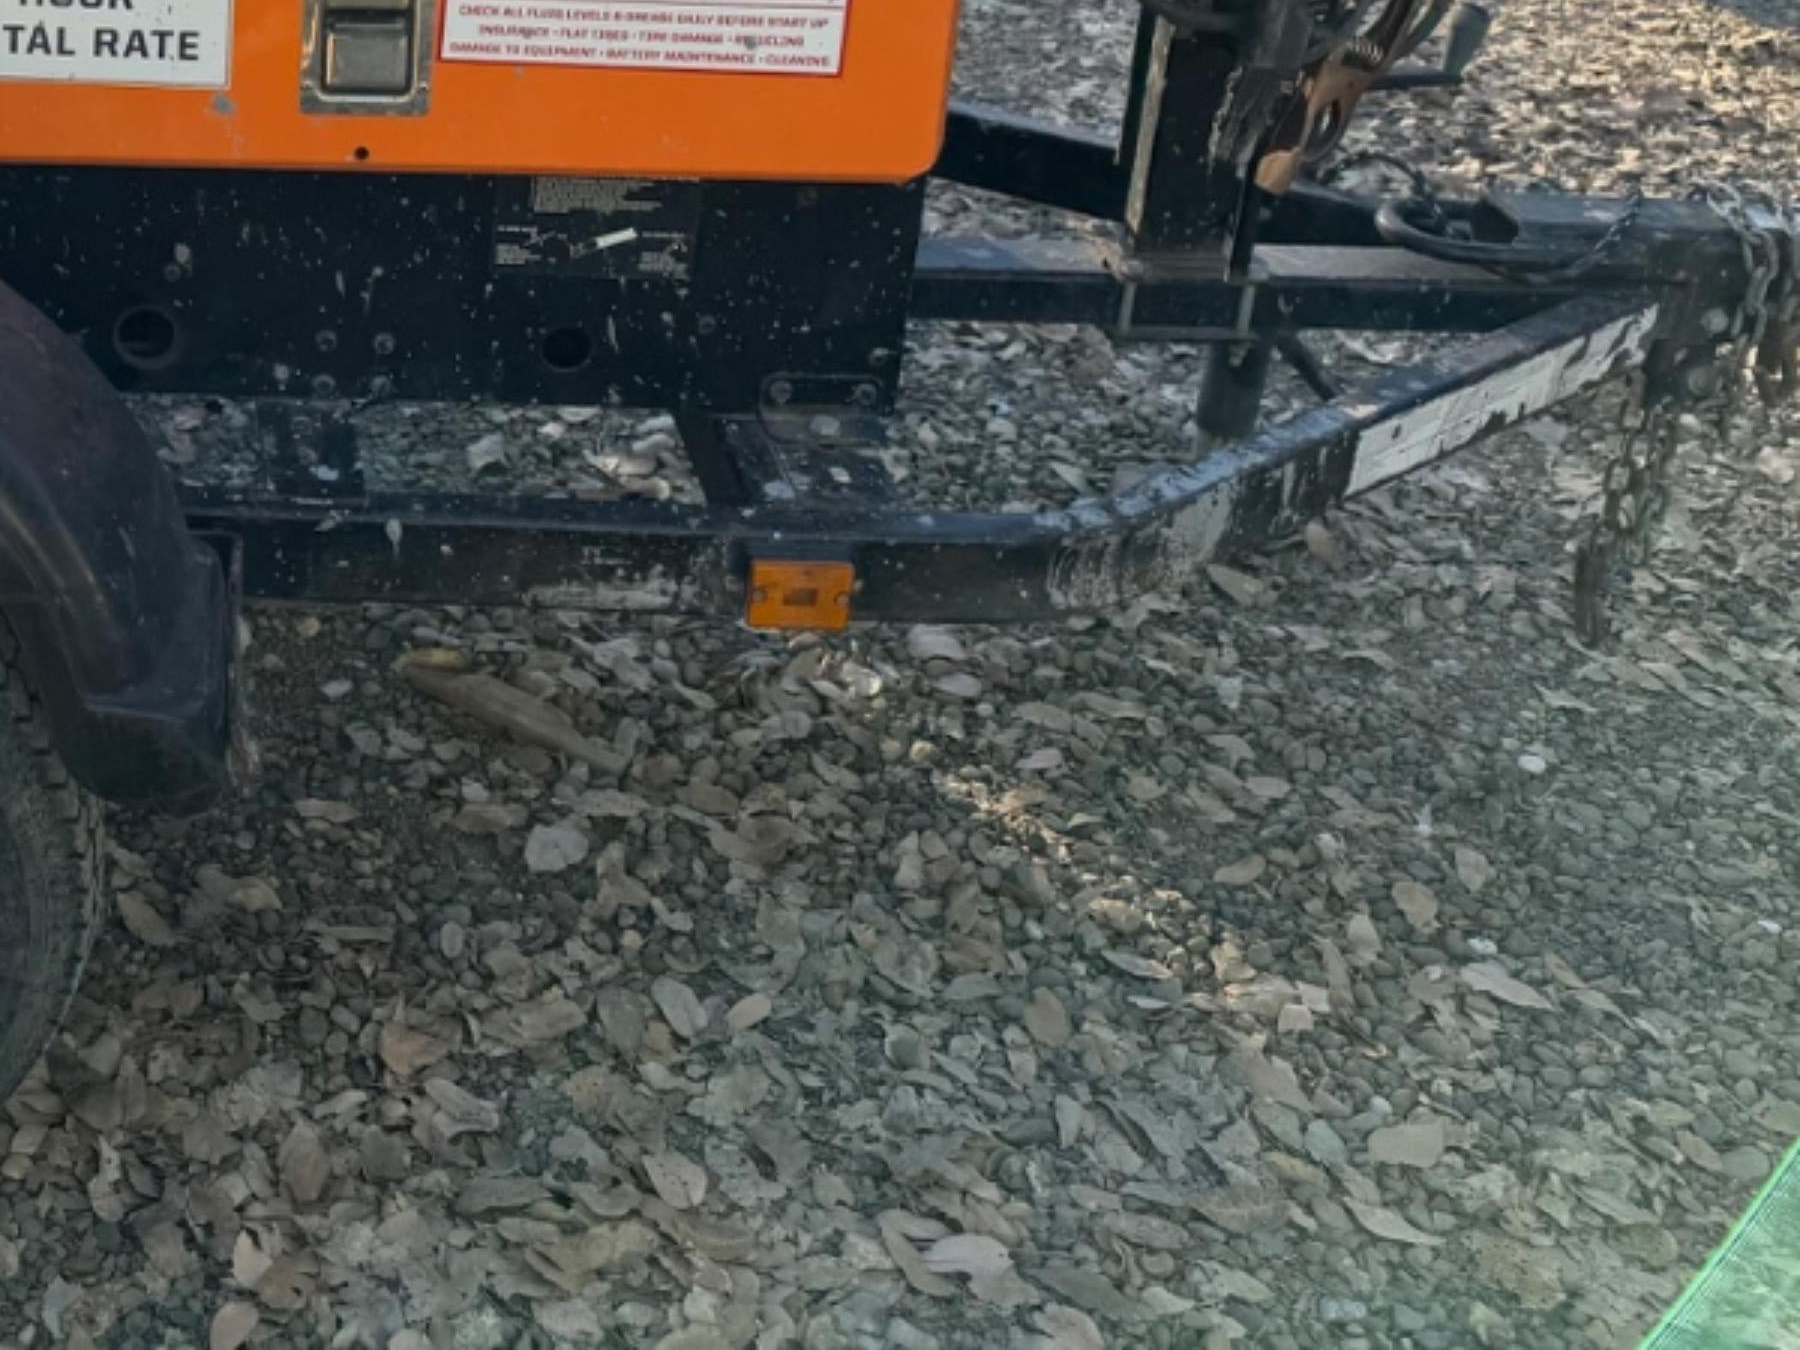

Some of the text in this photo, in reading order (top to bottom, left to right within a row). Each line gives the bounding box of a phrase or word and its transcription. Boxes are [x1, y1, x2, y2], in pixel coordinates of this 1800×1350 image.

[458, 3, 500, 17] CHECK
[566, 7, 610, 22] LEVELS
[92, 26, 201, 62] RATE
